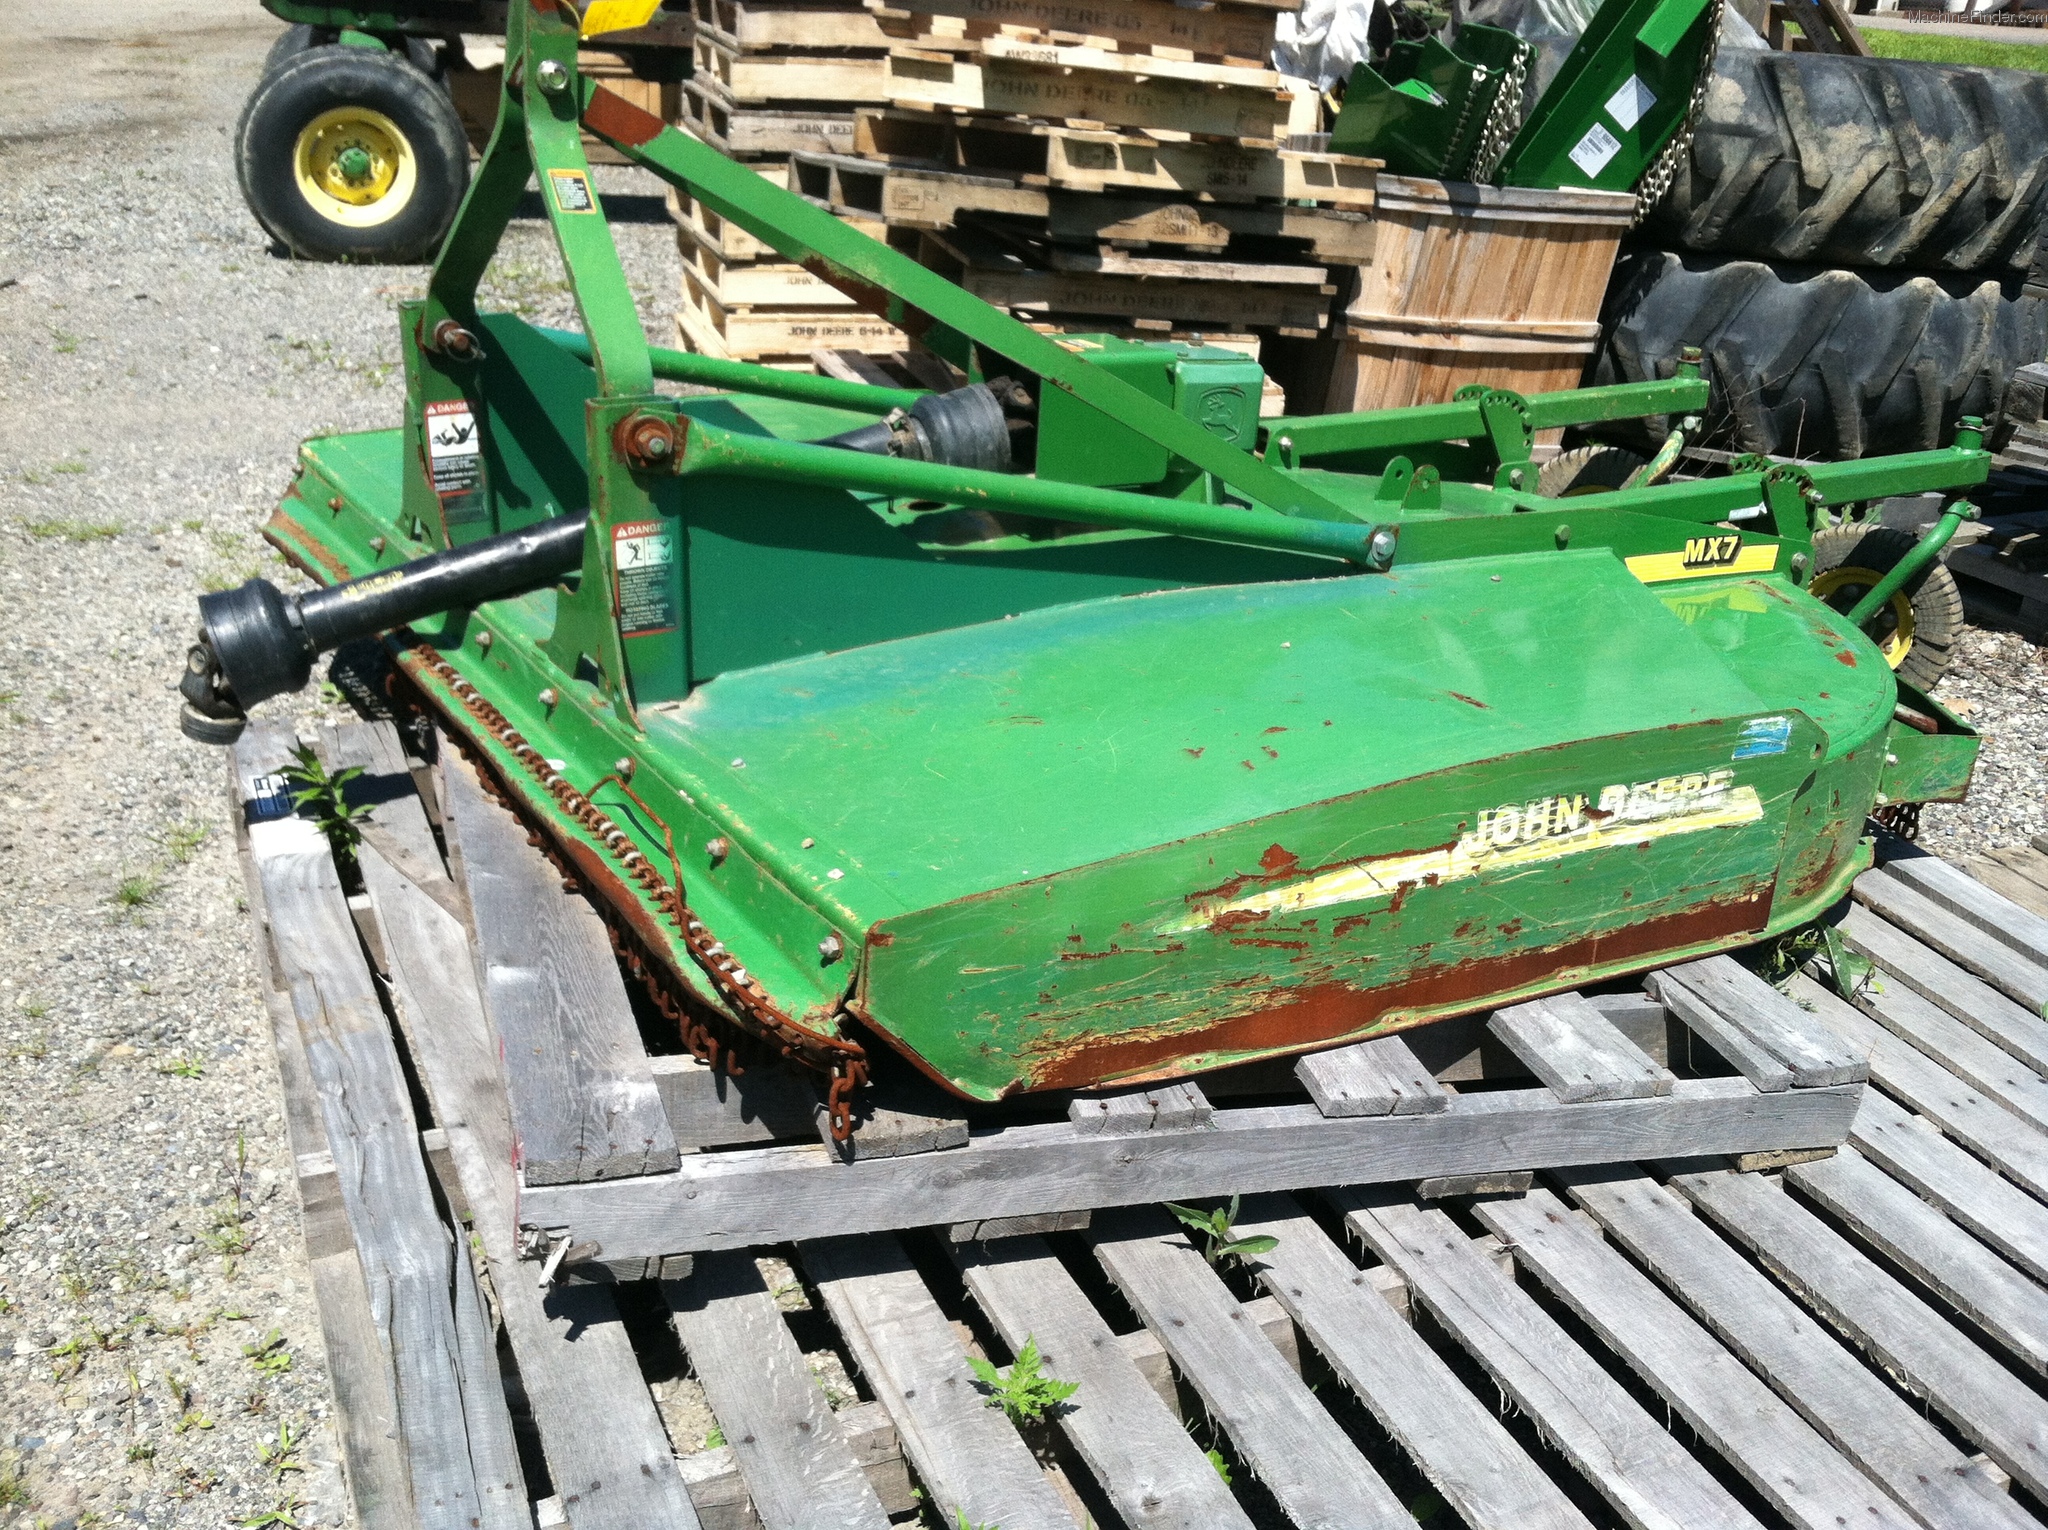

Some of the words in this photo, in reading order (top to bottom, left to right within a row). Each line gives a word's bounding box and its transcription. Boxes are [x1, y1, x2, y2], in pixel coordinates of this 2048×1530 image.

[793, 123, 824, 135] JOHN
[788, 326, 817, 336] JOHN
[822, 326, 854, 336] DEERE
[437, 401, 469, 413] DANGE
[1683, 535, 1742, 569] MX7
[1461, 793, 1590, 855] JOHN
